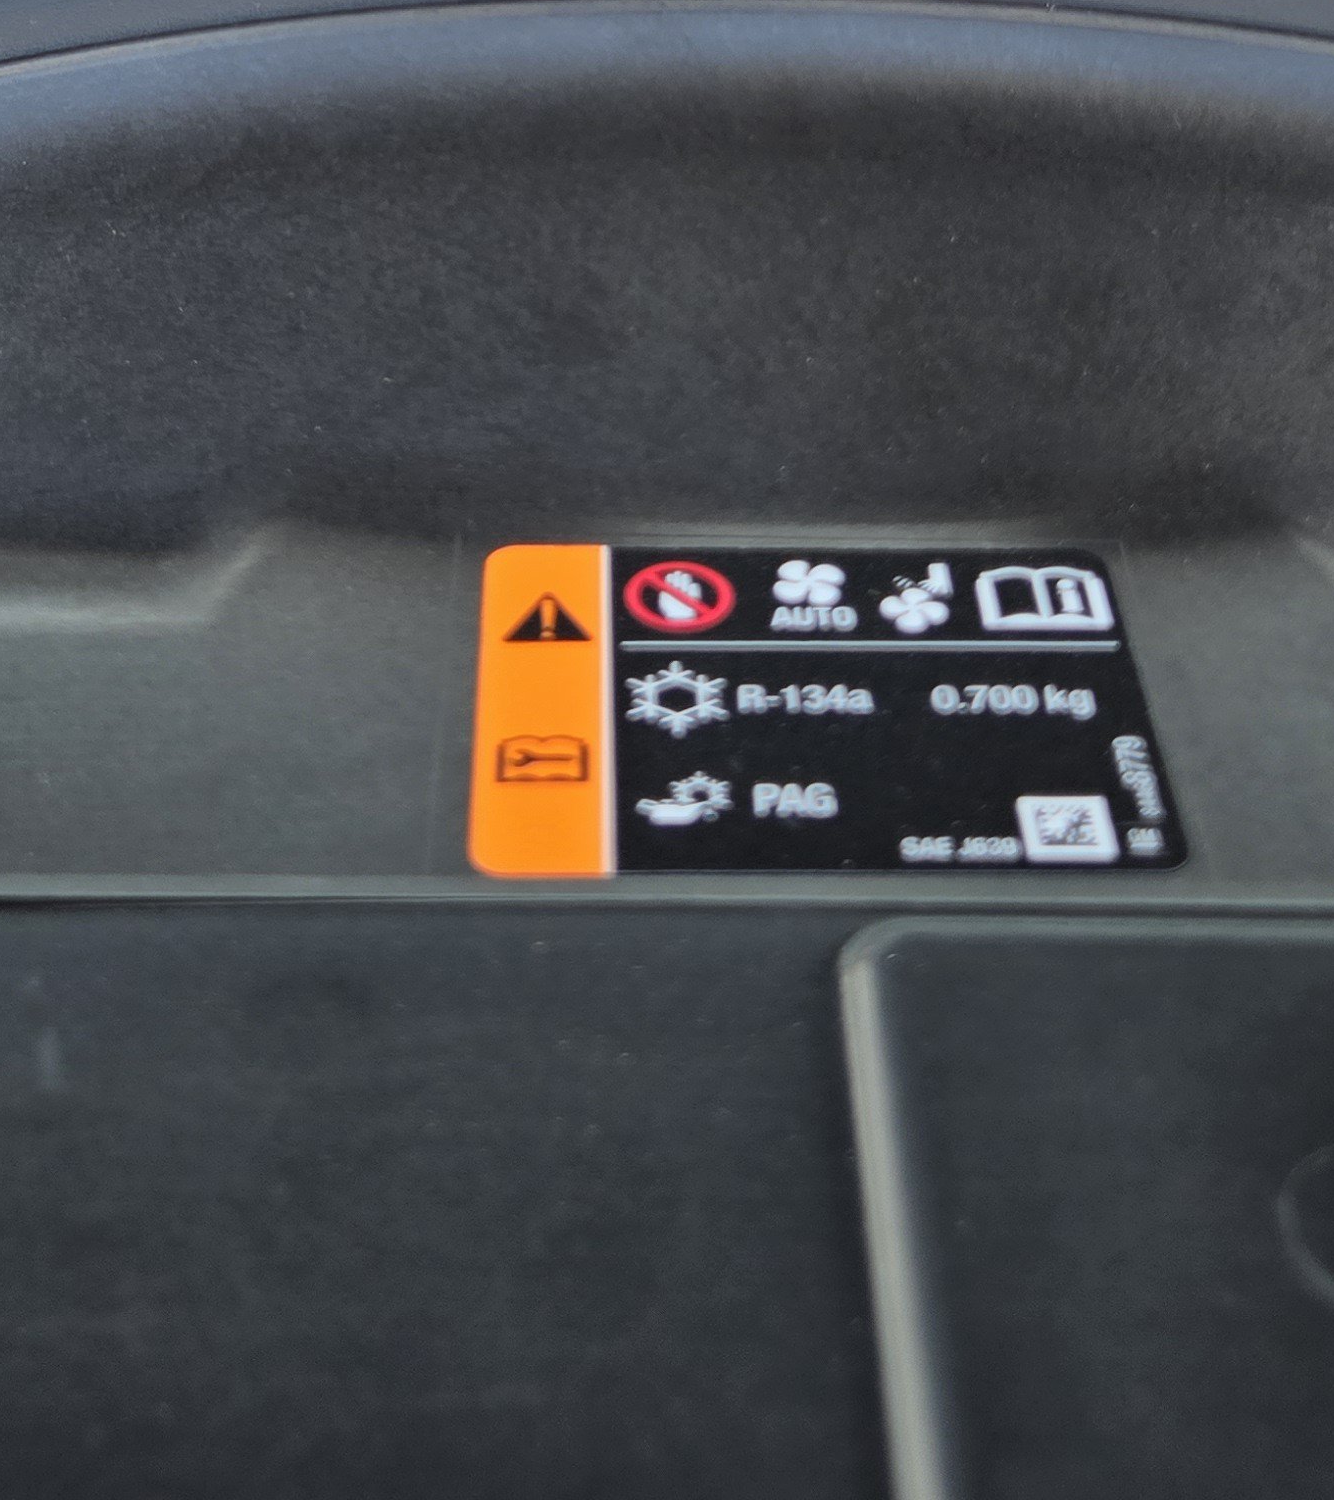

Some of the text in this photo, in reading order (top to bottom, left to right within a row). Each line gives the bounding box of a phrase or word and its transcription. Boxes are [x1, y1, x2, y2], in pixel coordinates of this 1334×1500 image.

[770, 605, 858, 632] AUTO
[736, 683, 1097, 721] R-134a 0.700 kg
[752, 782, 839, 818] PAG
[899, 836, 954, 861] SAE
